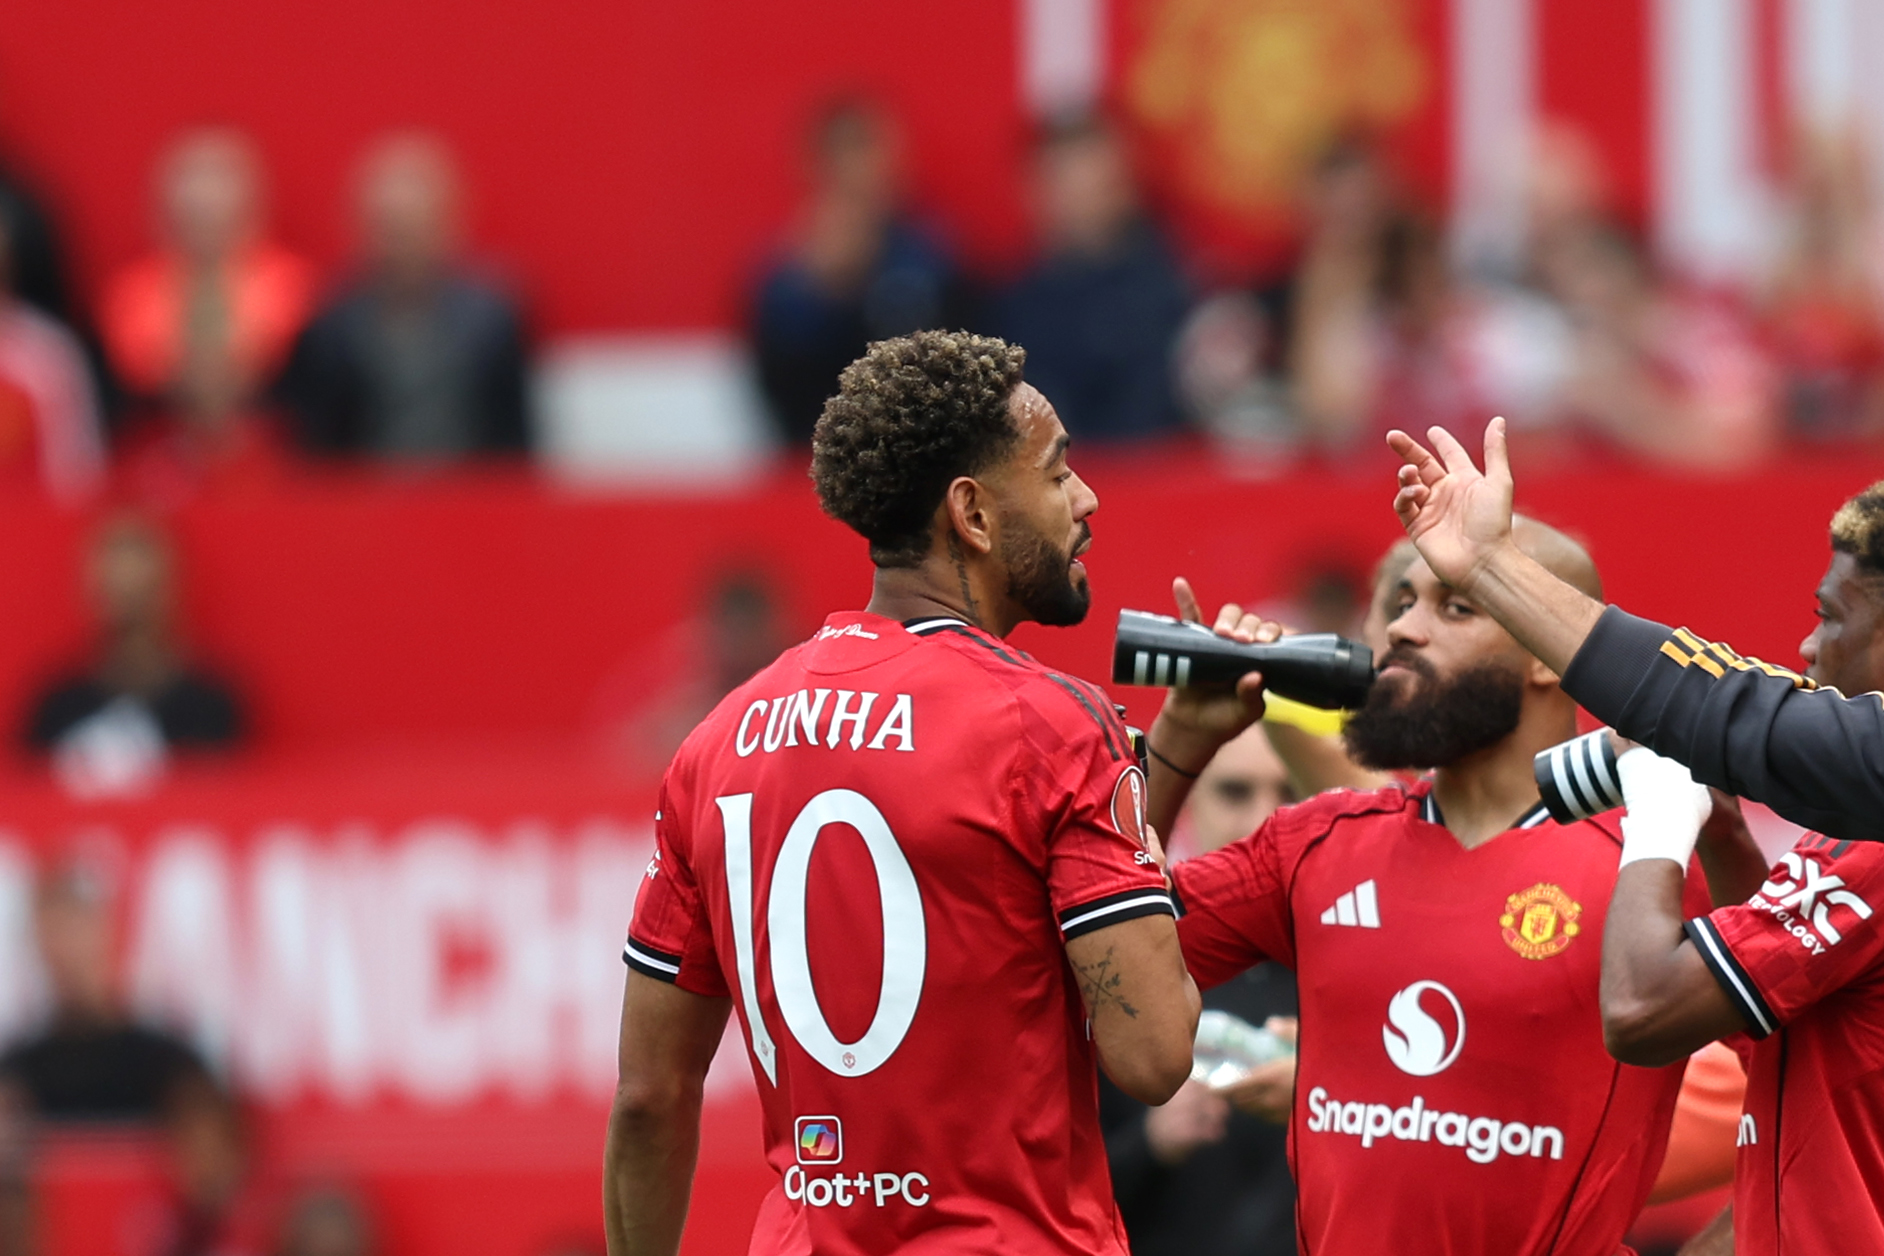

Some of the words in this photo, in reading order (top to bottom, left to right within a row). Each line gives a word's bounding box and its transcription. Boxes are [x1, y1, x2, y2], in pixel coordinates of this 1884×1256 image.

[736, 688, 915, 757] CUNHA
[715, 787, 927, 1089] 10
[1307, 1086, 1565, 1164] Snapdragon
